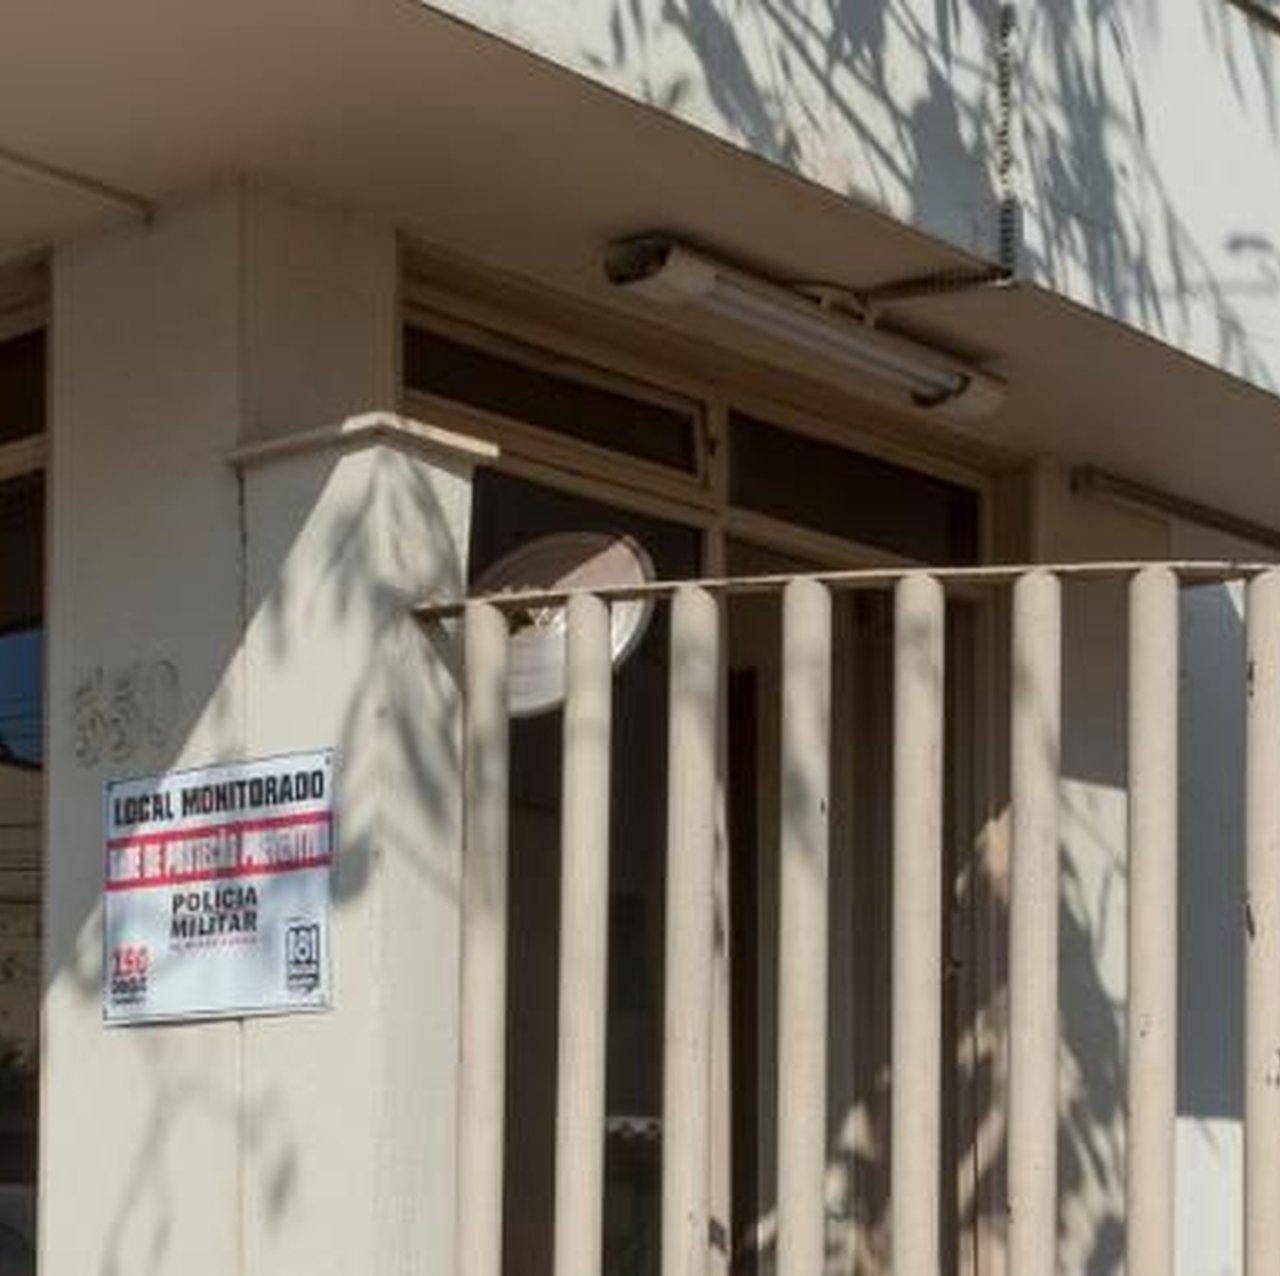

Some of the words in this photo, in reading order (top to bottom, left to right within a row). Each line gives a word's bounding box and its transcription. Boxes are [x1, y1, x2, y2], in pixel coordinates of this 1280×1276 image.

[114, 794, 174, 827] LOCAL
[181, 770, 324, 819] MONITORADO
[170, 910, 257, 938] MILITAR
